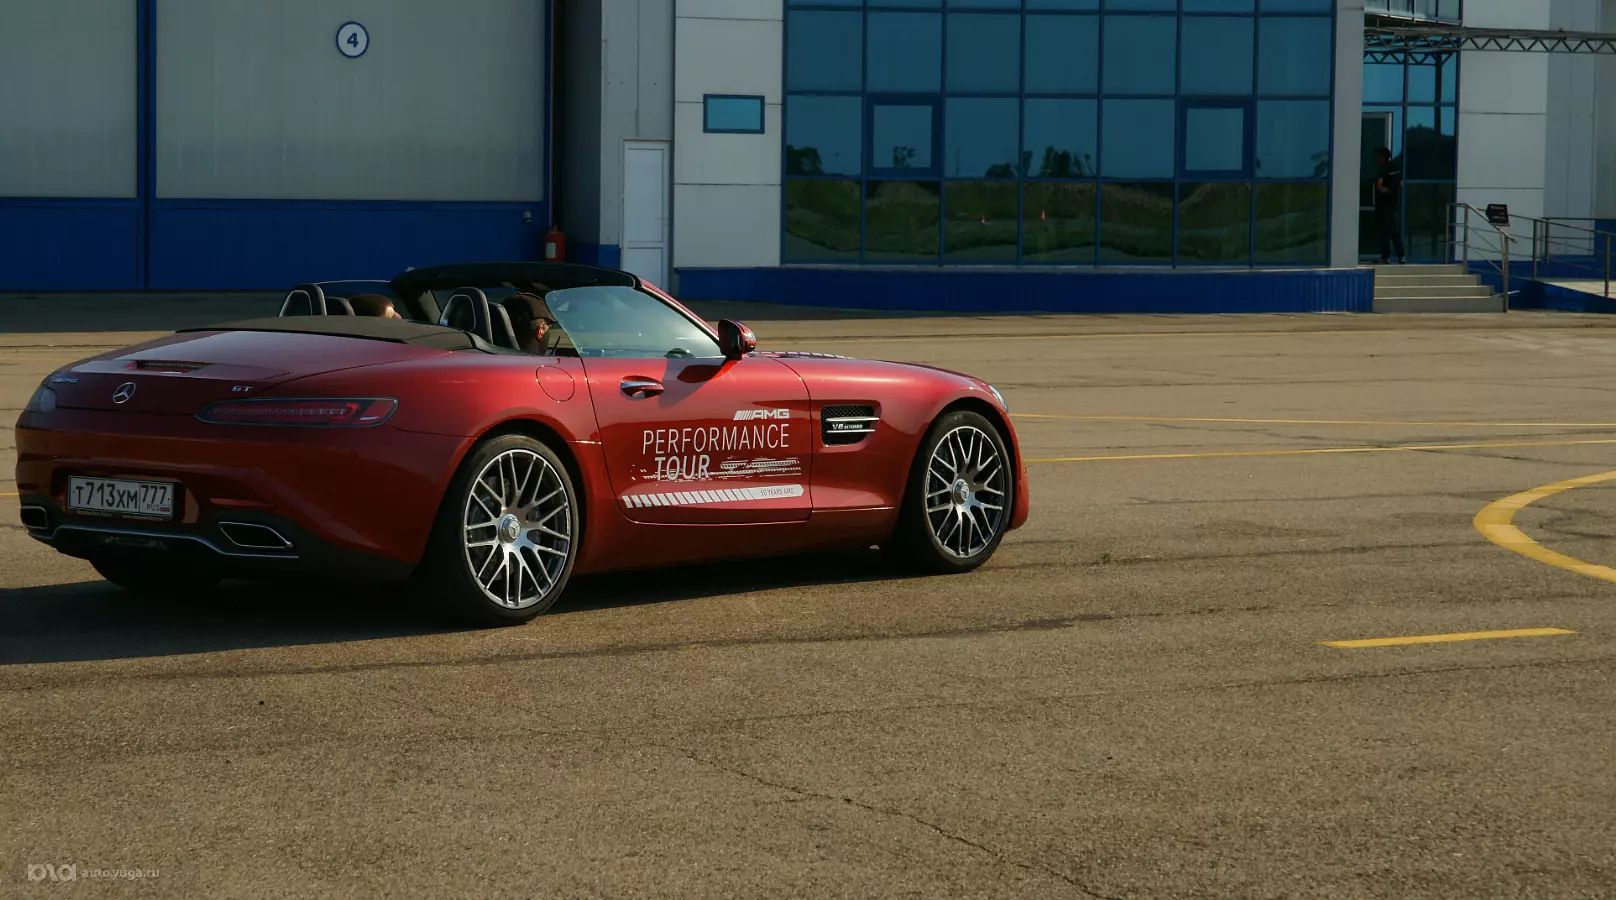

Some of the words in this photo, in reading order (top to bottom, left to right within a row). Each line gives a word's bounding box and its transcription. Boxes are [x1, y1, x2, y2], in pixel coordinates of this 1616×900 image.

[347, 32, 359, 48] 4
[750, 408, 790, 420] AMG
[642, 423, 790, 455] PERFORMANCE
[654, 454, 711, 481] TOUR
[141, 484, 167, 504] 777
[767, 488, 783, 496] YEARS
[784, 487, 795, 495] AMG
[146, 503, 160, 511] RUS
